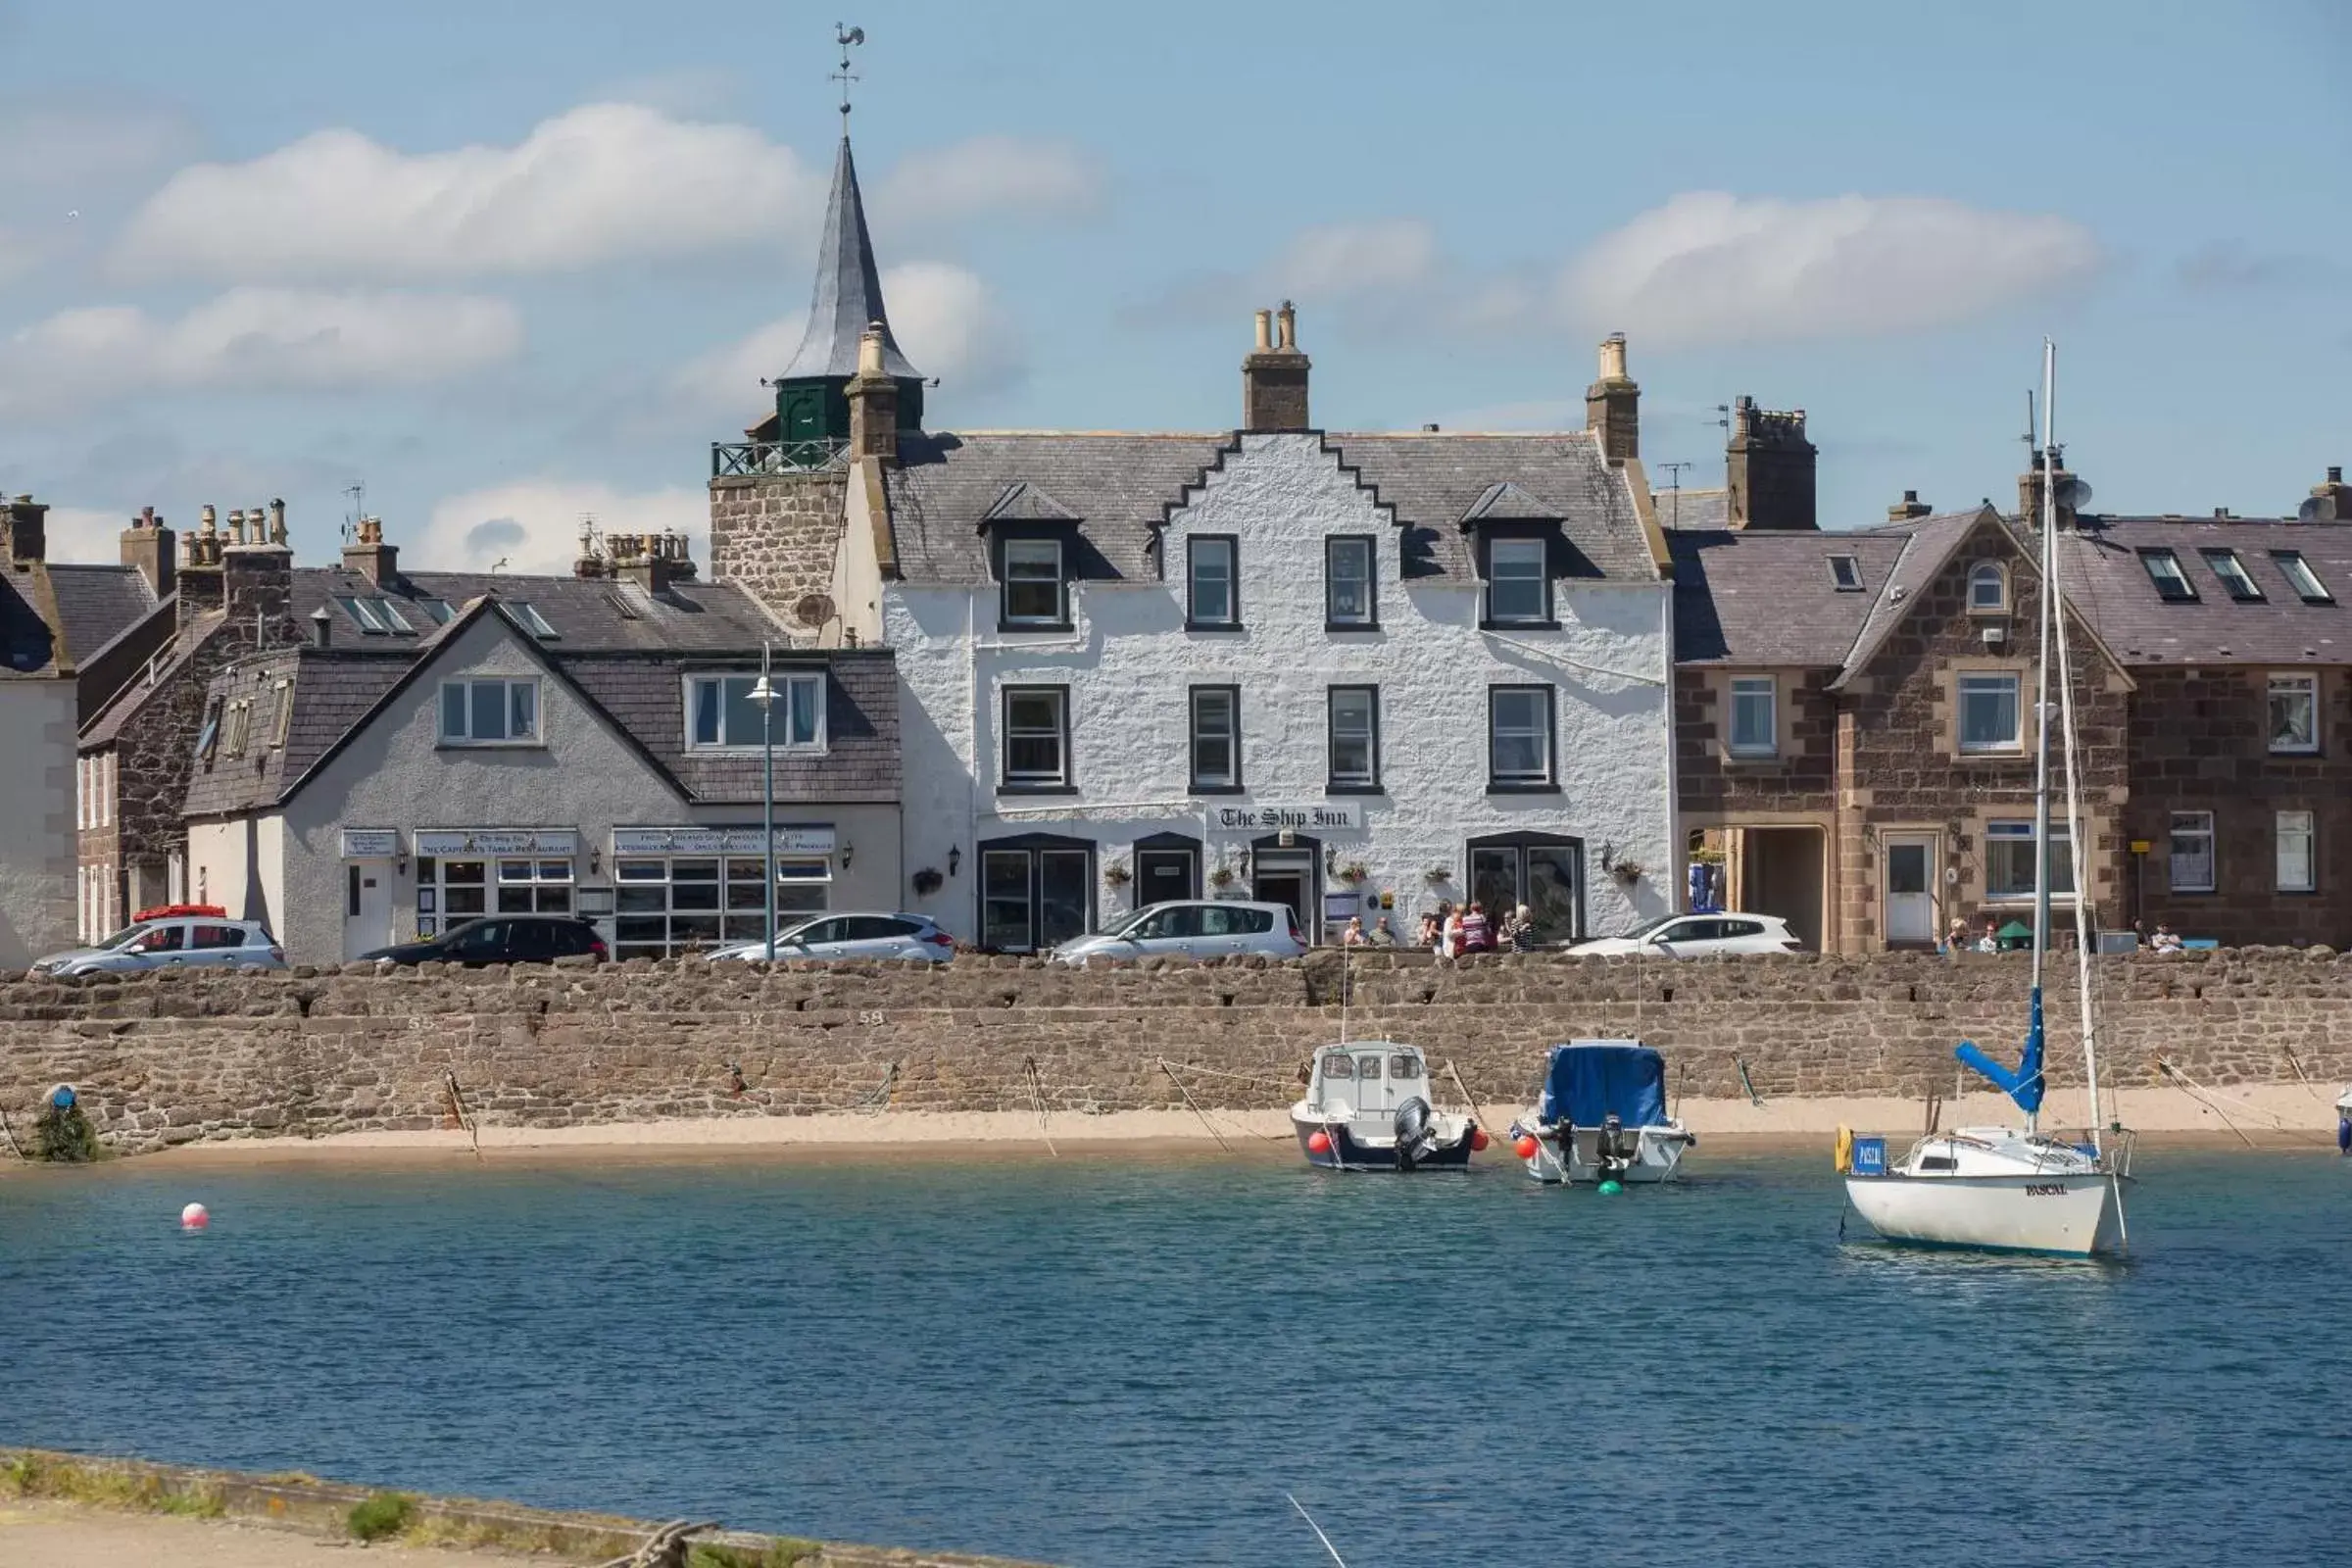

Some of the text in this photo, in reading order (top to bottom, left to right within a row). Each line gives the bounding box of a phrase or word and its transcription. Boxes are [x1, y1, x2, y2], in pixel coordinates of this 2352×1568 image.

[1220, 807, 1348, 829] The Ship Inn
[2025, 1183, 2070, 1197] PASCAL
